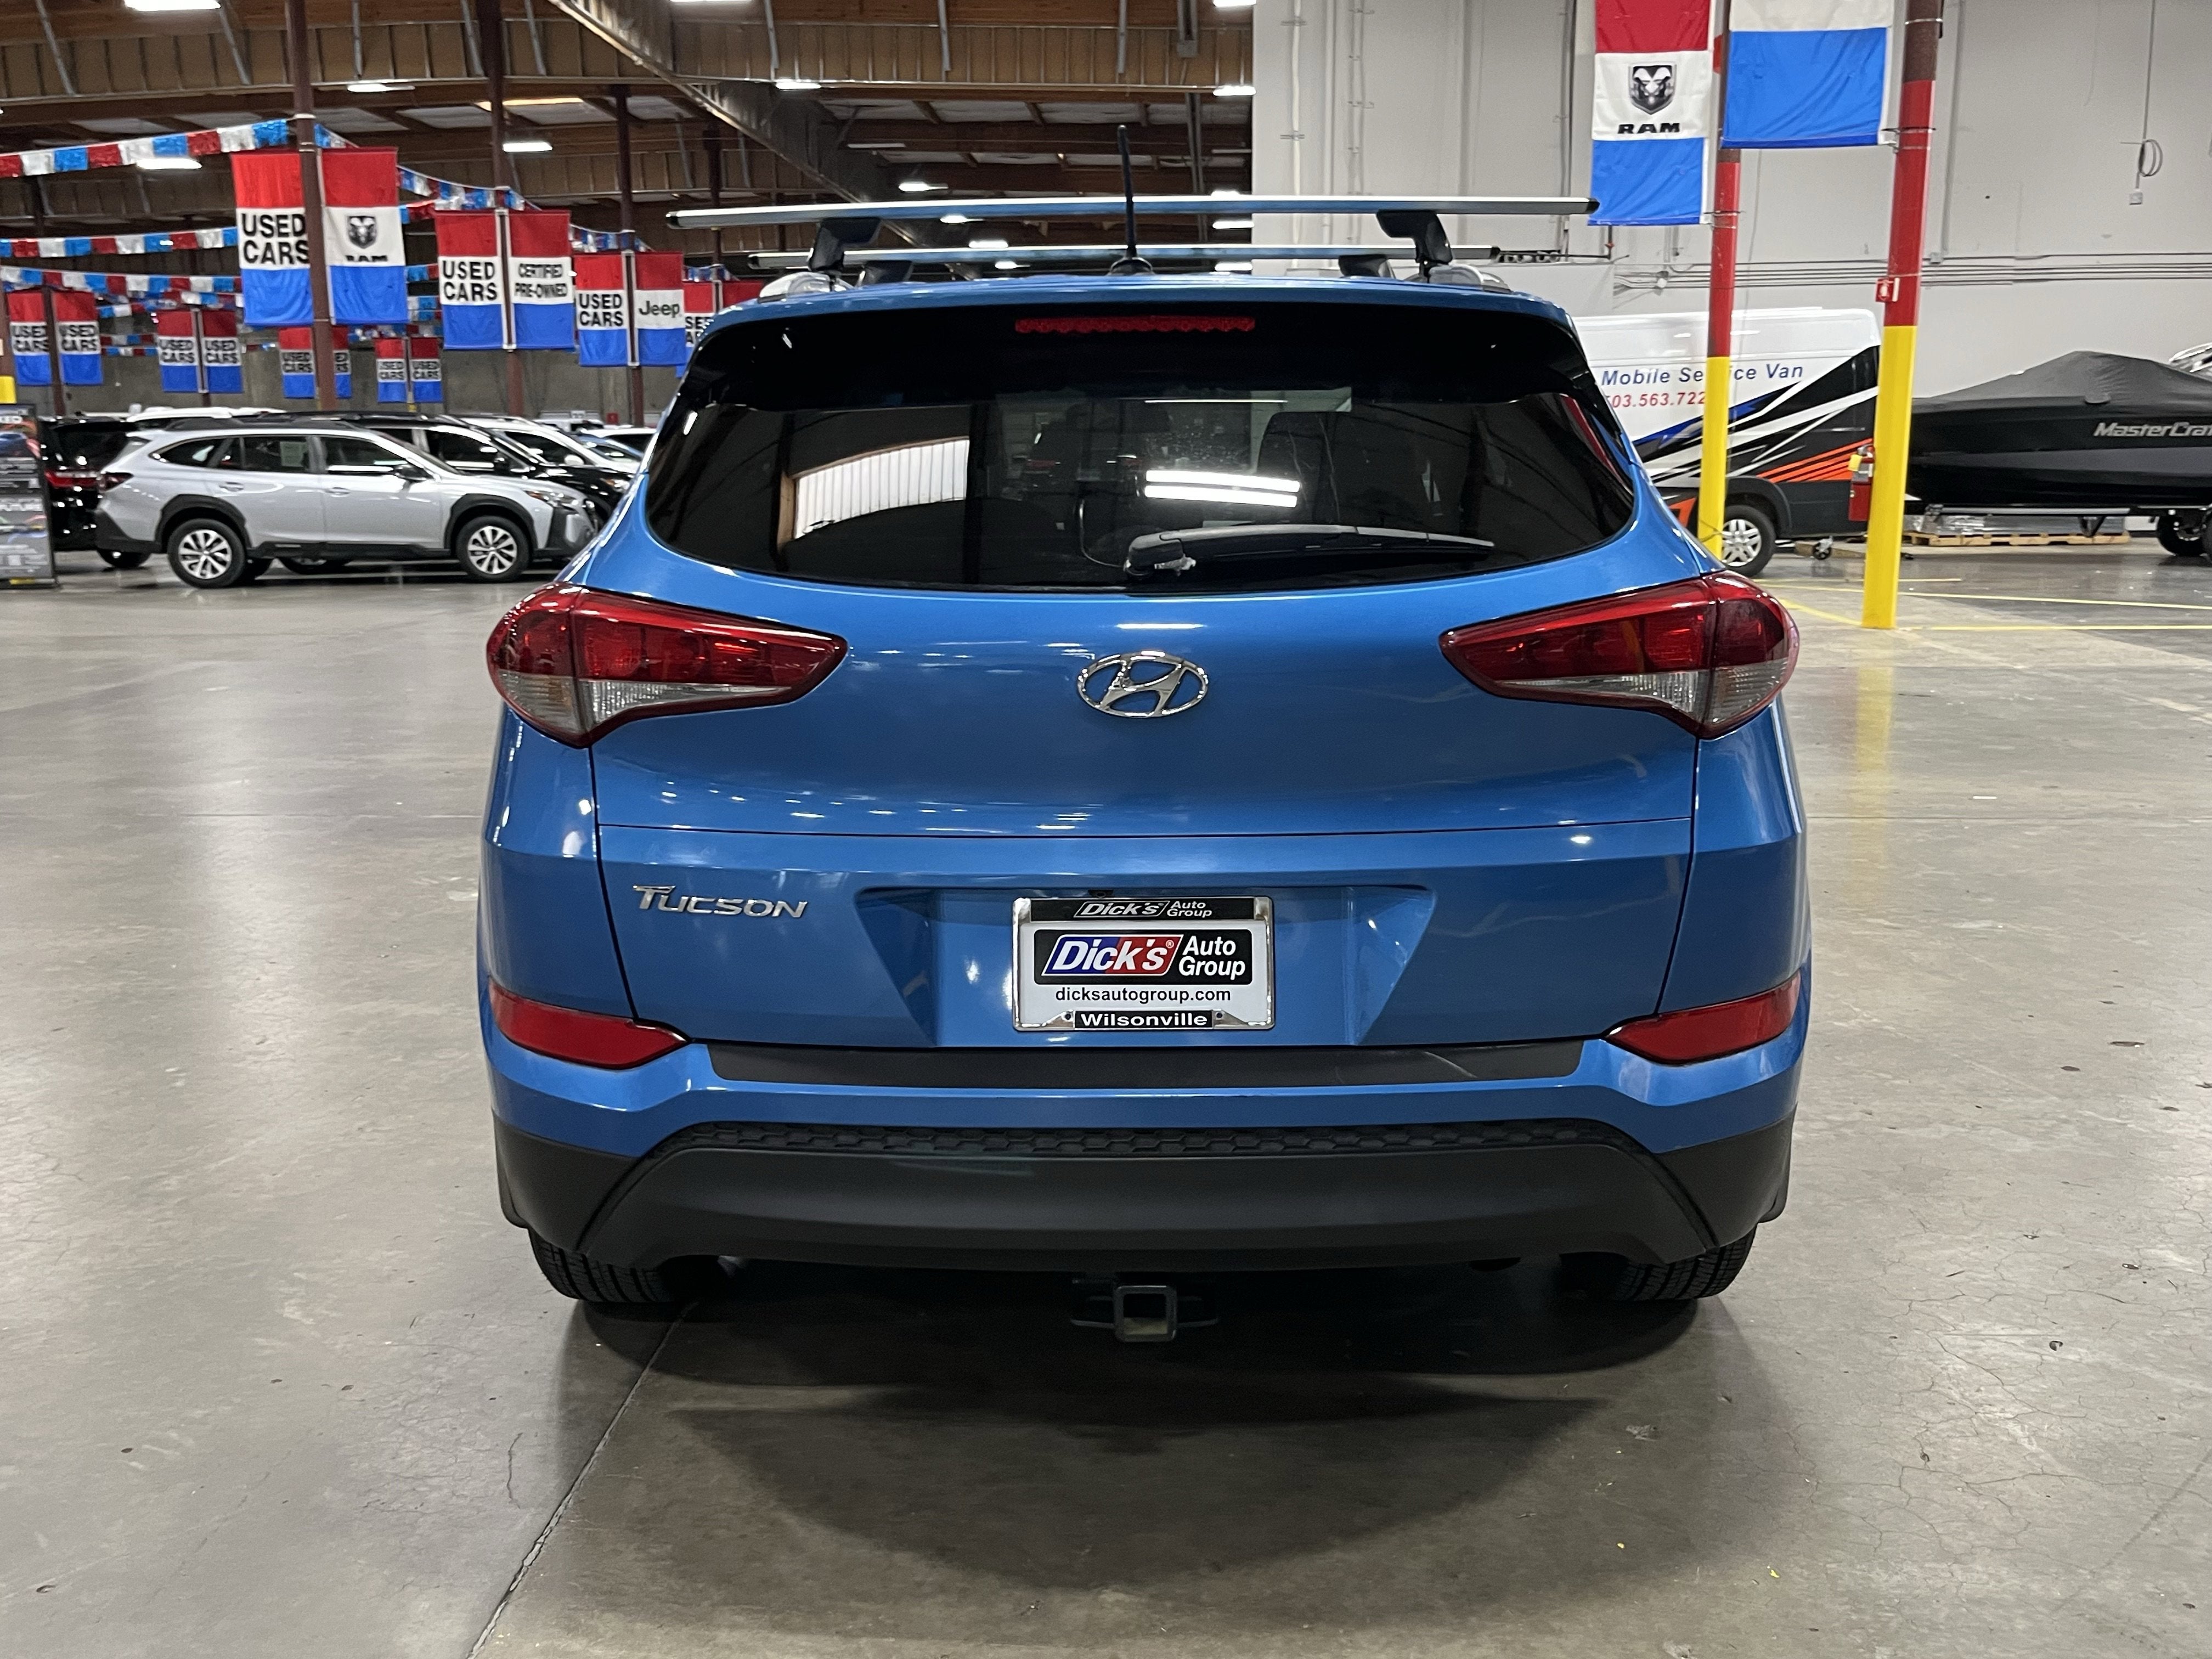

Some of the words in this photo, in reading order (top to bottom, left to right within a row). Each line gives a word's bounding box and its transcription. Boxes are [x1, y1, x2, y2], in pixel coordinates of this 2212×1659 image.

[1617, 122, 1680, 134] RAM
[241, 213, 306, 238] USED
[243, 240, 309, 264] CARS
[442, 261, 495, 280] USED
[443, 281, 497, 301] CARS
[579, 293, 622, 309] USED
[639, 300, 680, 318] Jeep
[579, 311, 623, 326] CARS
[1601, 368, 1671, 386] Mobile
[1679, 365, 1757, 382] Sece
[1766, 363, 1803, 379] Van
[1166, 908, 1212, 918] Group
[1182, 935, 1237, 956] Auto
[1178, 956, 1246, 980] Group
[1055, 988, 1231, 1004] dicksautogroup.com
[1080, 1013, 1208, 1026] Wilsonville
